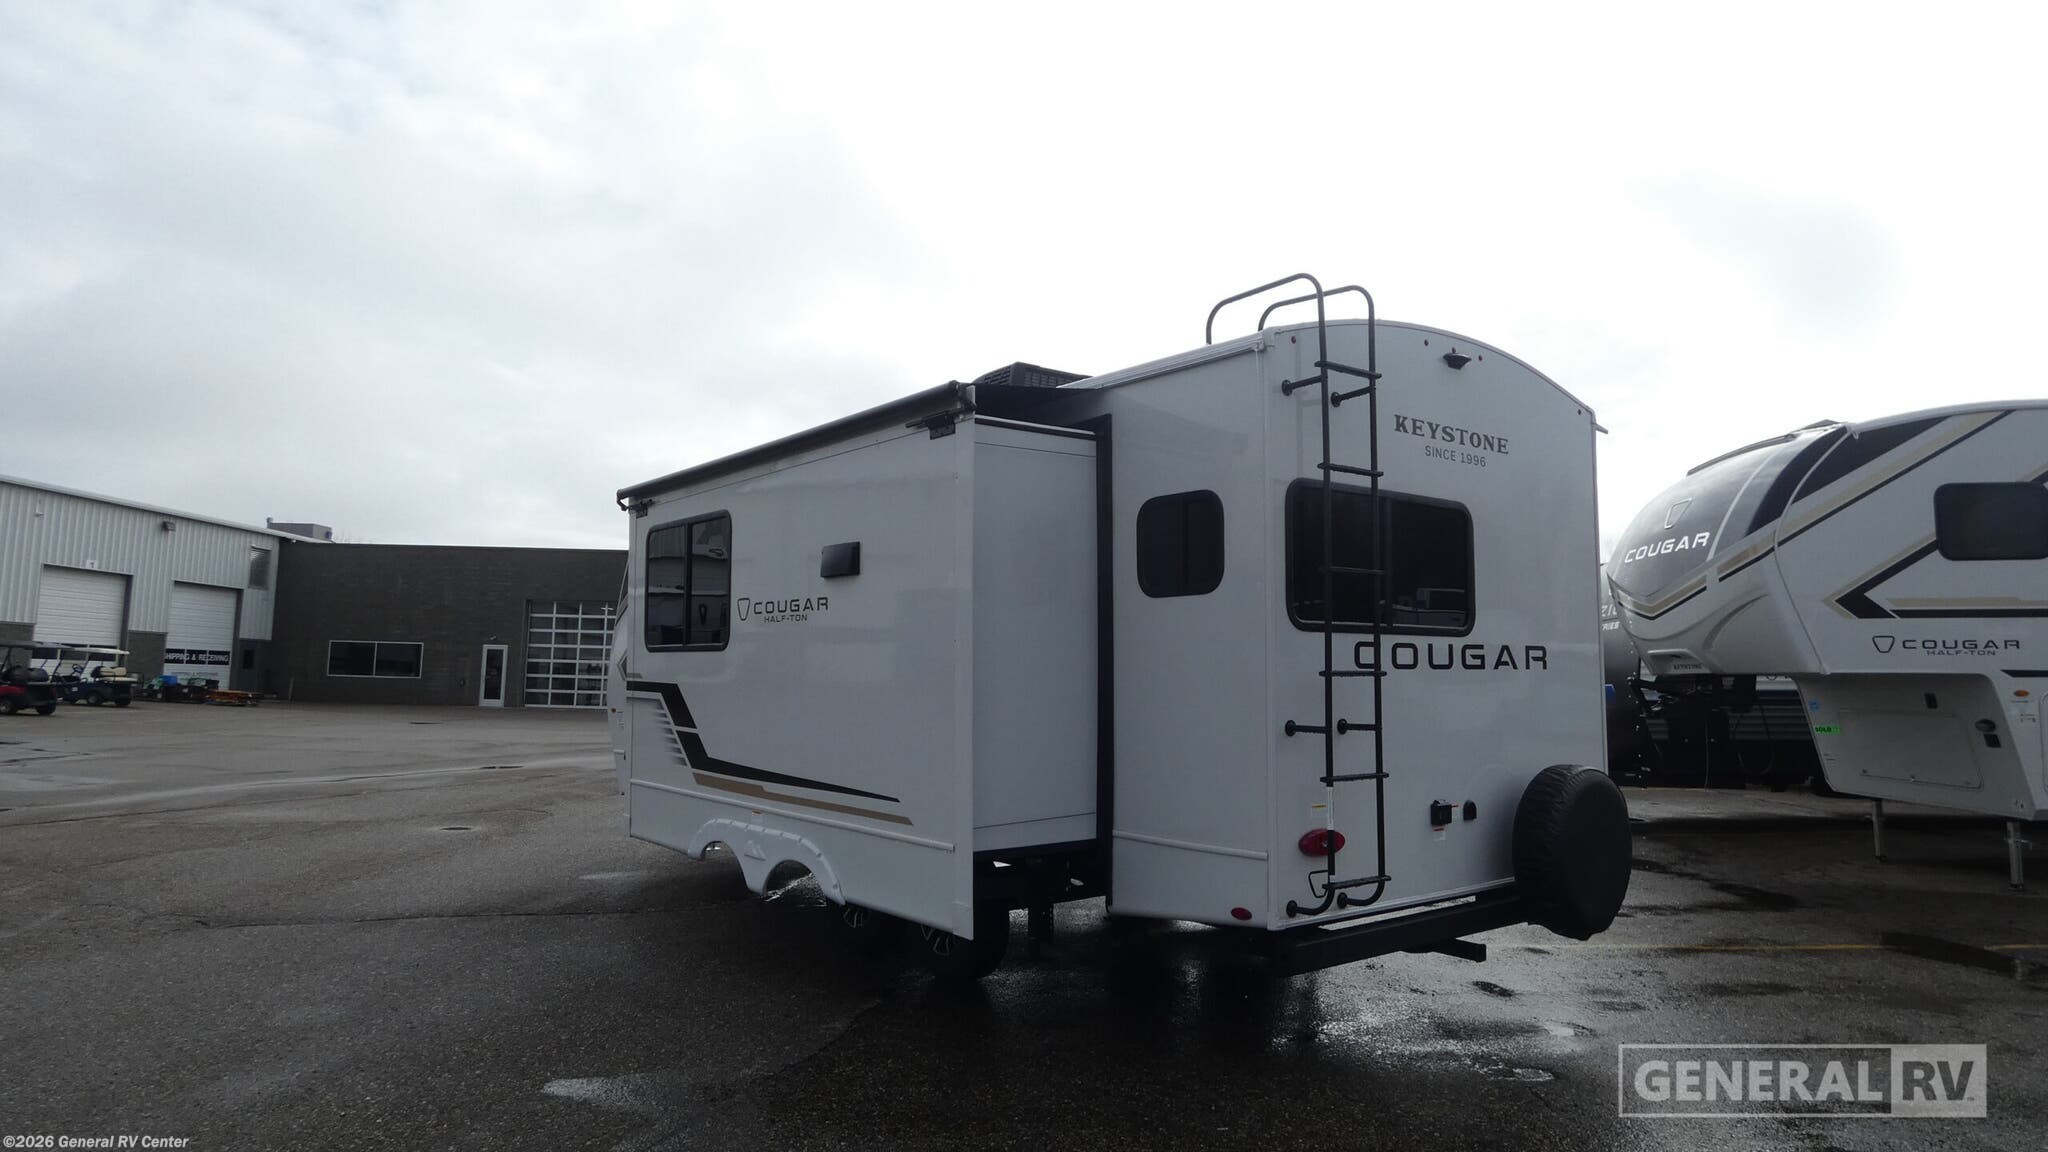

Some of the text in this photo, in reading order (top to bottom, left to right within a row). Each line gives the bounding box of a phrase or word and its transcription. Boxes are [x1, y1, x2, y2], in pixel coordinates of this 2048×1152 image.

[1394, 414, 1509, 455] KEYSTONE
[1424, 445, 1487, 467] SINCE 1996
[1624, 531, 1711, 564] COUGAR
[753, 597, 829, 615] COUGAR
[763, 614, 808, 623] HALF-TON
[1902, 639, 2020, 650] COUGAR
[199, 654, 230, 662] RECEIVING
[1354, 641, 1548, 670] COUGAR
